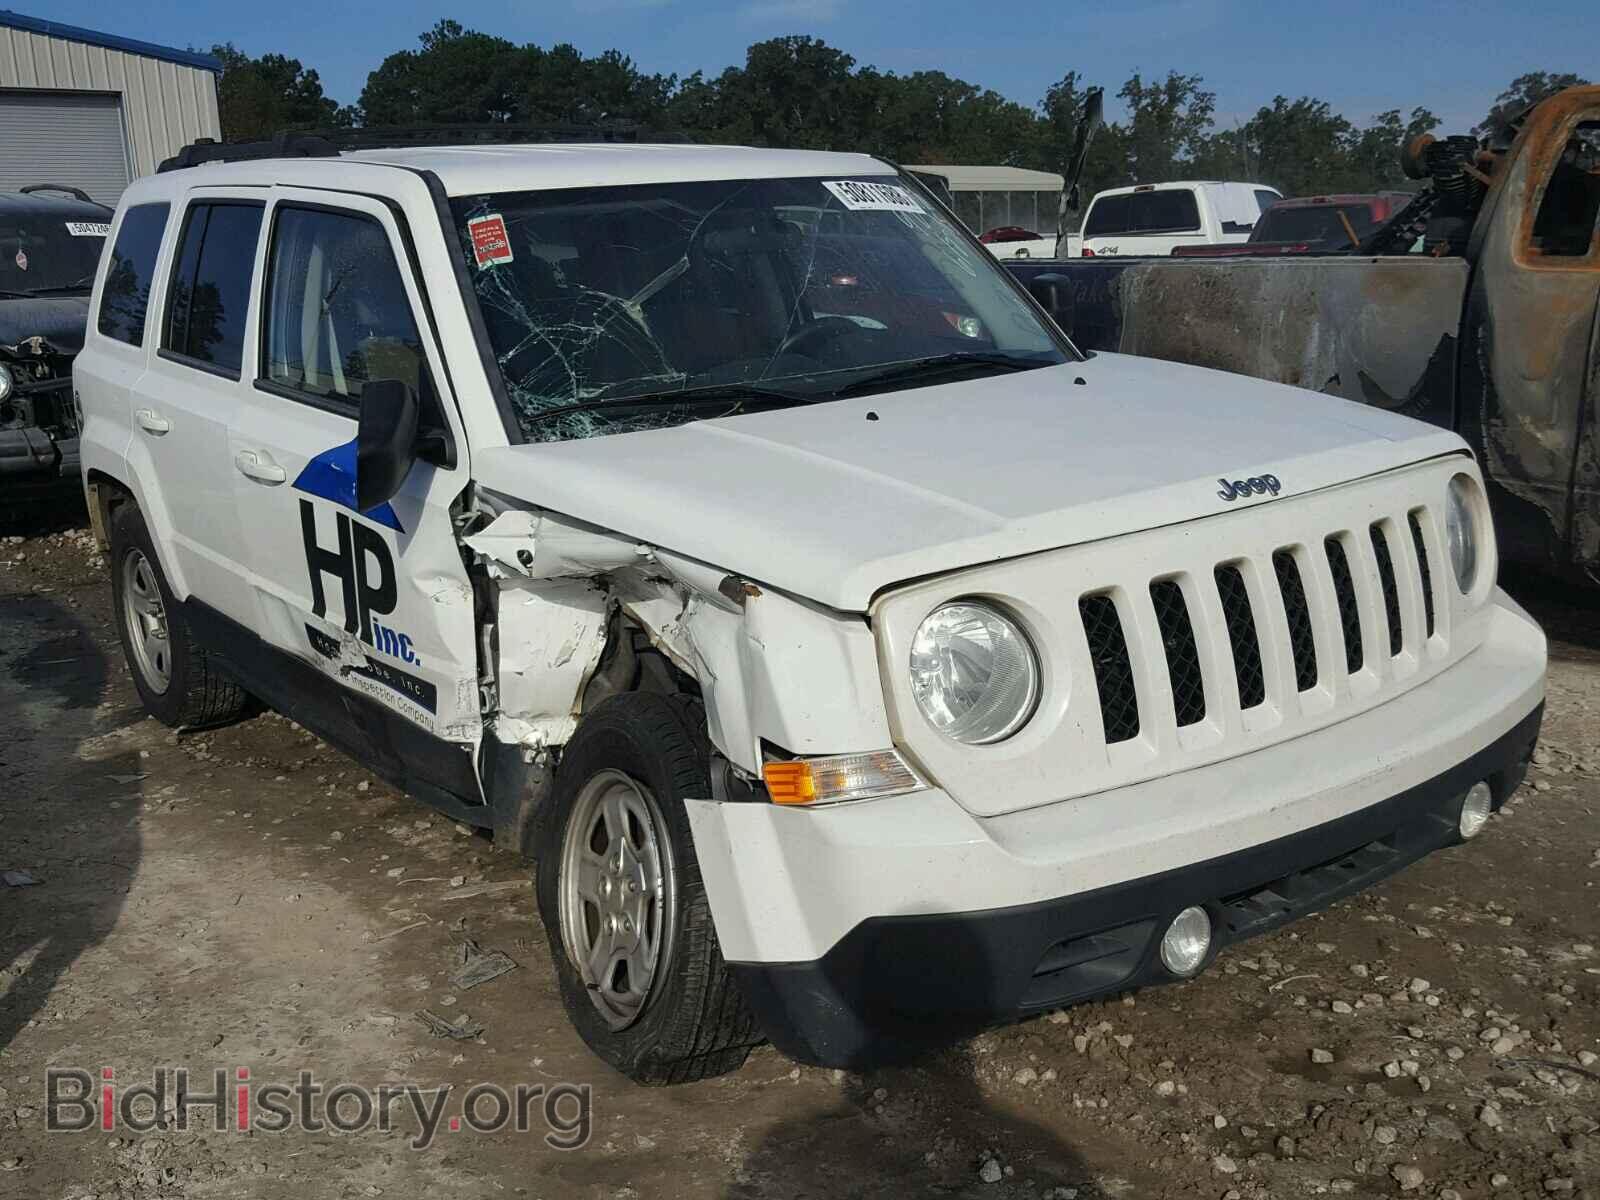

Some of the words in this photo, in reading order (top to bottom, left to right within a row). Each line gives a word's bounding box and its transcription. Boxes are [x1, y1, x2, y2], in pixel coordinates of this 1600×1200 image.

[1217, 474, 1281, 501] Jeep
[299, 498, 397, 647] HP
[373, 617, 421, 666] inc.
[397, 696, 435, 729] Company
